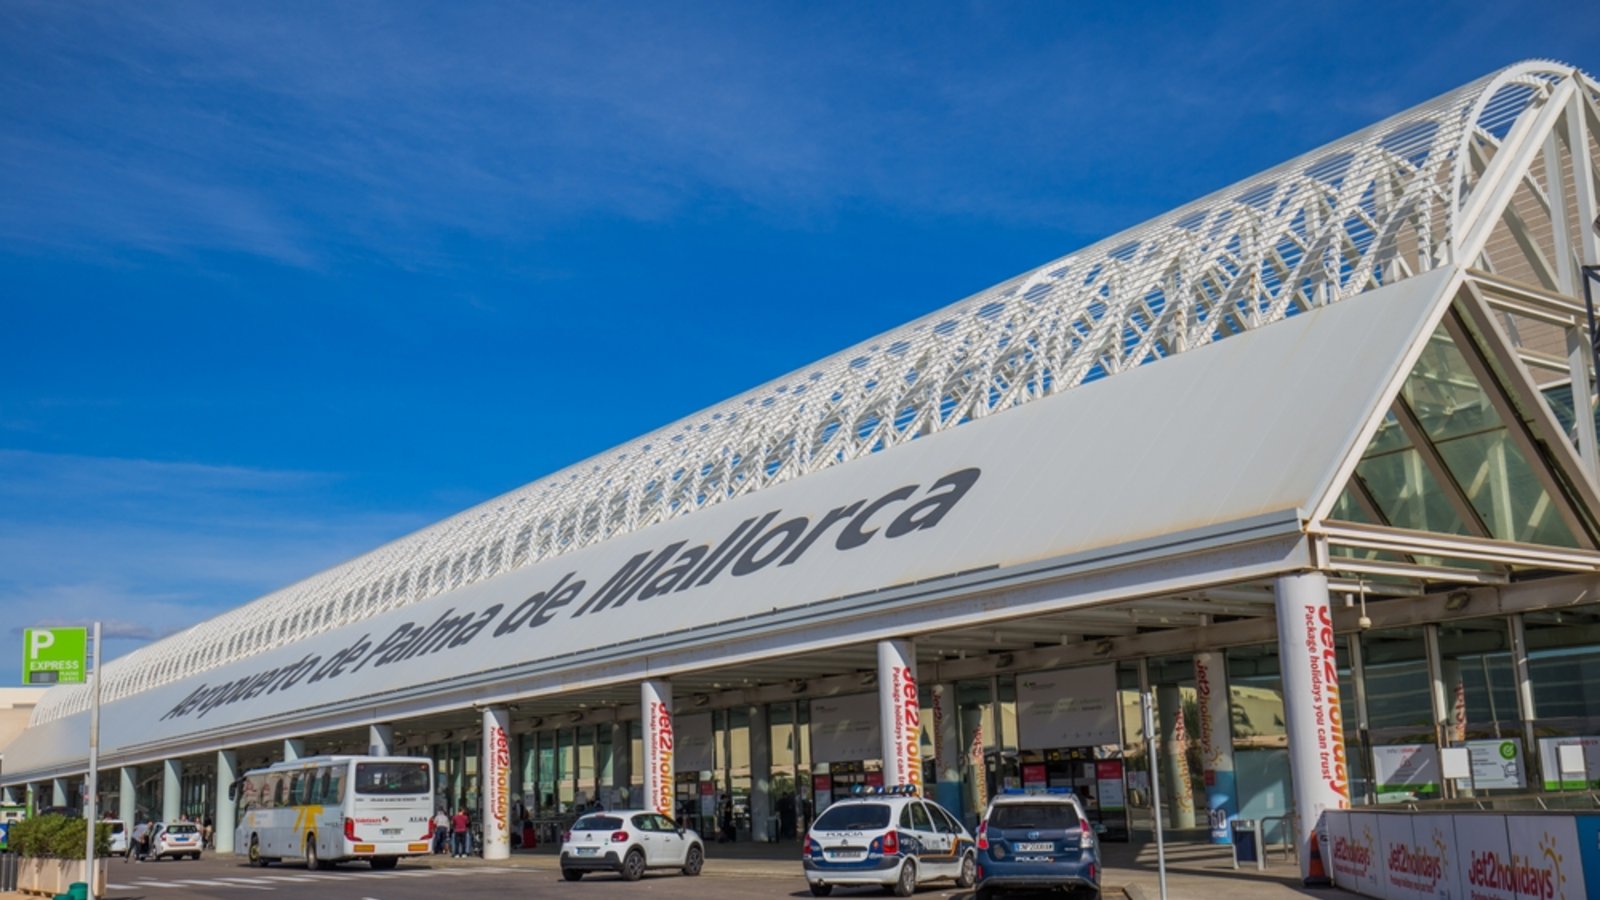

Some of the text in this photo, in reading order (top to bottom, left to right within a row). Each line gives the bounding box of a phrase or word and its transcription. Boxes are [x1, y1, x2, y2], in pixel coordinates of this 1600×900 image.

[160, 467, 981, 721] Aeropuerto de Palma de Mallorca
[31, 629, 55, 659] P
[30, 660, 79, 671] EXPRESS
[892, 666, 900, 702] Package
[1304, 605, 1332, 780] Package holidays you can trust
[894, 705, 903, 739] holidays
